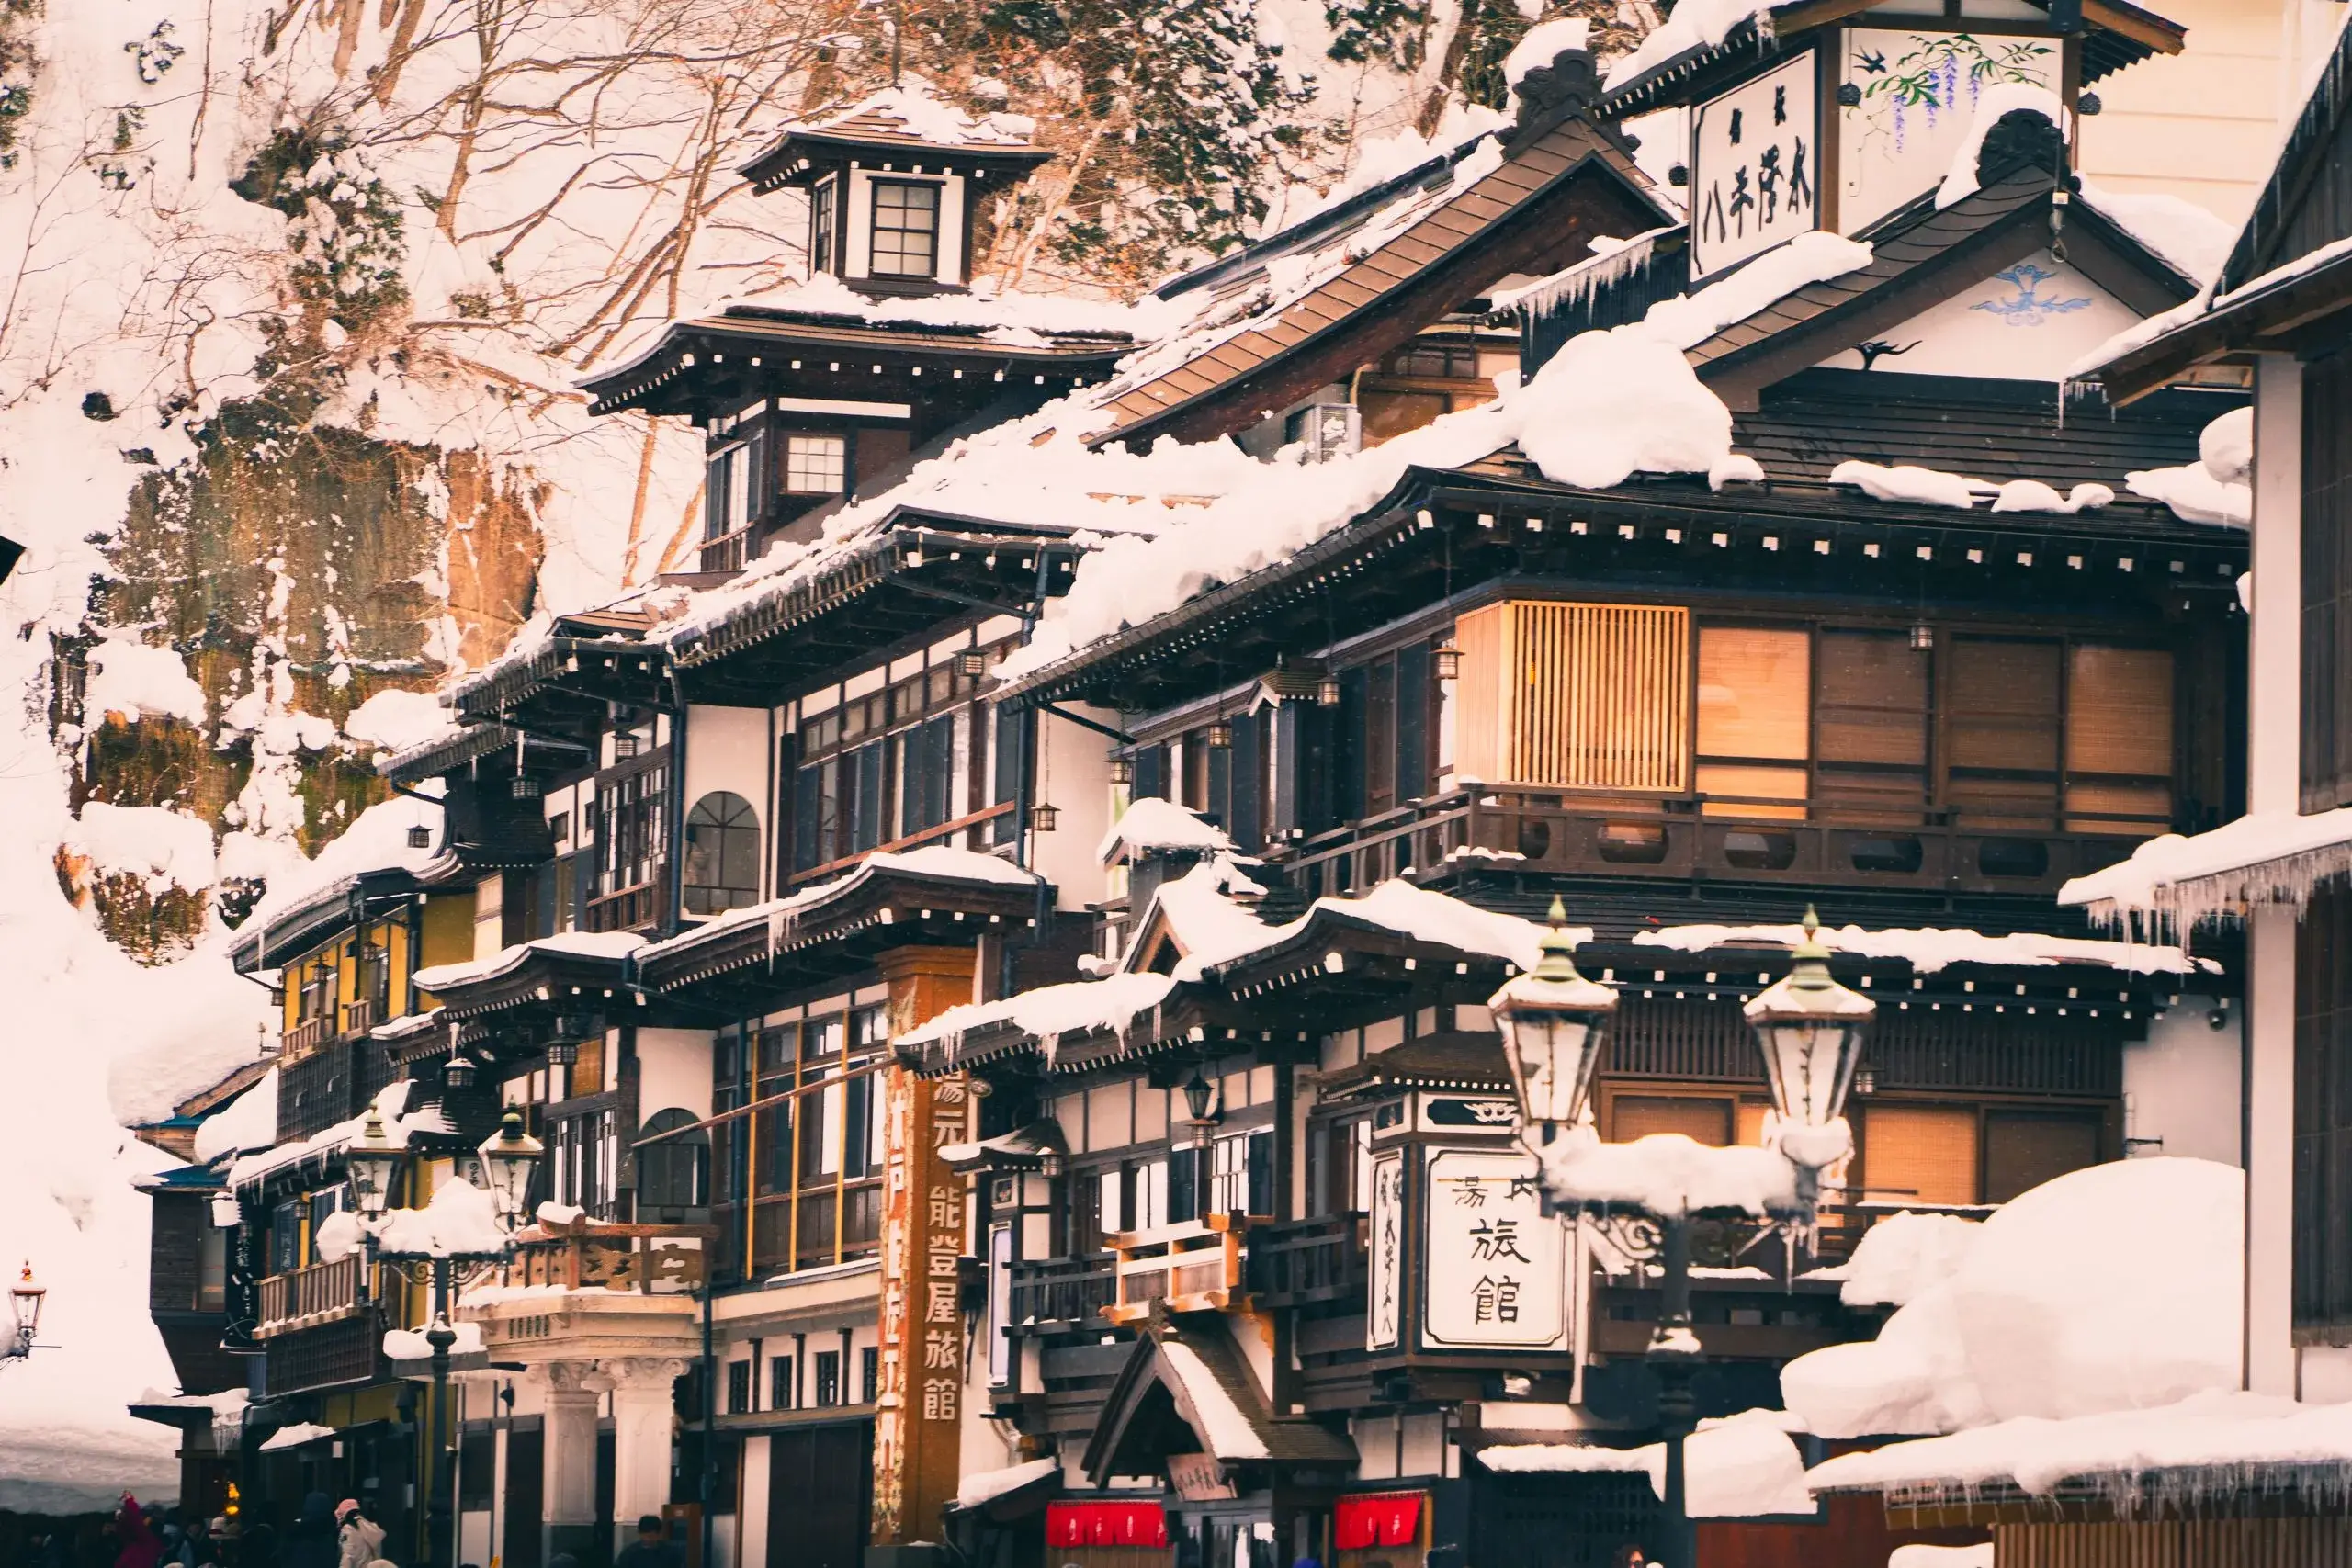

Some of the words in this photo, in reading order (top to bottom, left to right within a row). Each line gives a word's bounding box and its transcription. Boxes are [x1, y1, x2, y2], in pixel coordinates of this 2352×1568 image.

[922, 1185, 961, 1421] 能登屋旅館
[1470, 1218, 1531, 1325] 旅館
